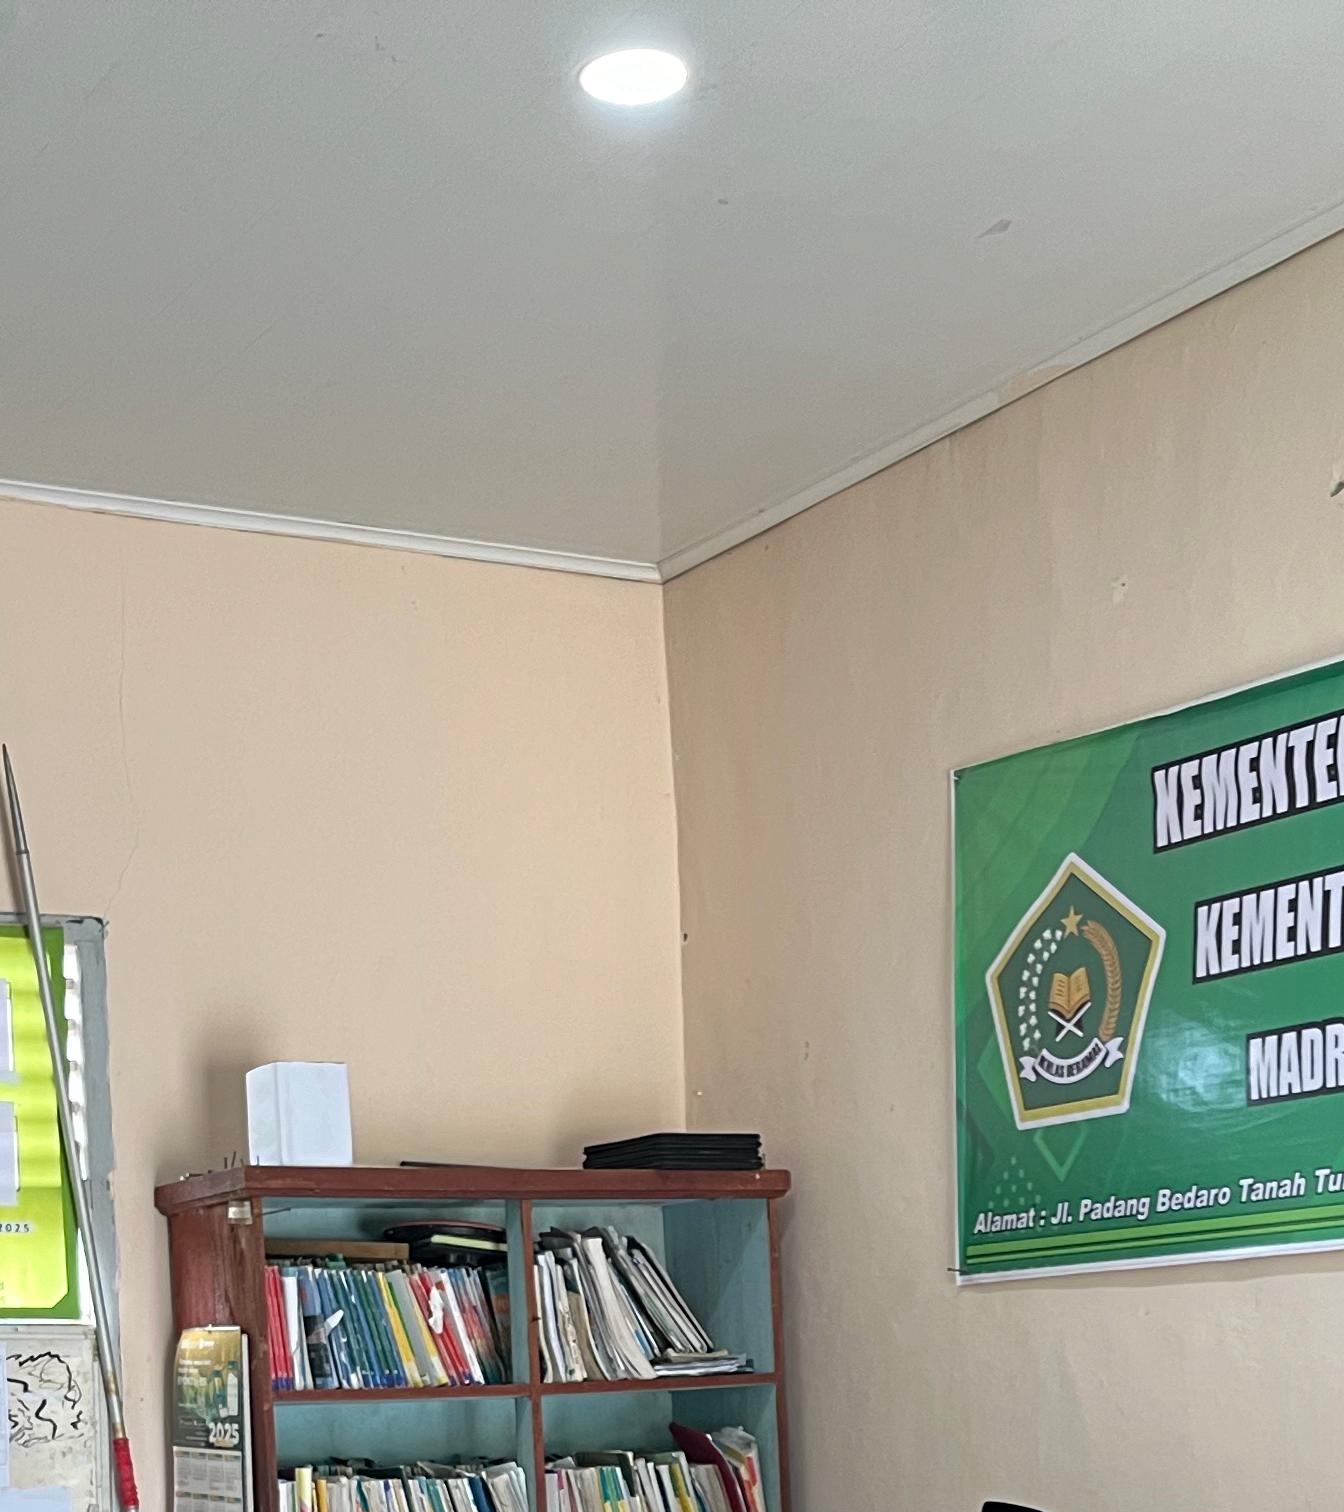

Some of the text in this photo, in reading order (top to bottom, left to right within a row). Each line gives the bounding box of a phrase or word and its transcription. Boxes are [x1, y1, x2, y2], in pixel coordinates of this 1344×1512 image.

[974, 1212, 1036, 1234] Alamat
[1051, 1202, 1071, 1225] Jl.
[1079, 1193, 1150, 1221] Padang
[1156, 1186, 1231, 1213] Bedaro
[1238, 1171, 1306, 1202] Tanah
[209, 1422, 239, 1444] 2025
